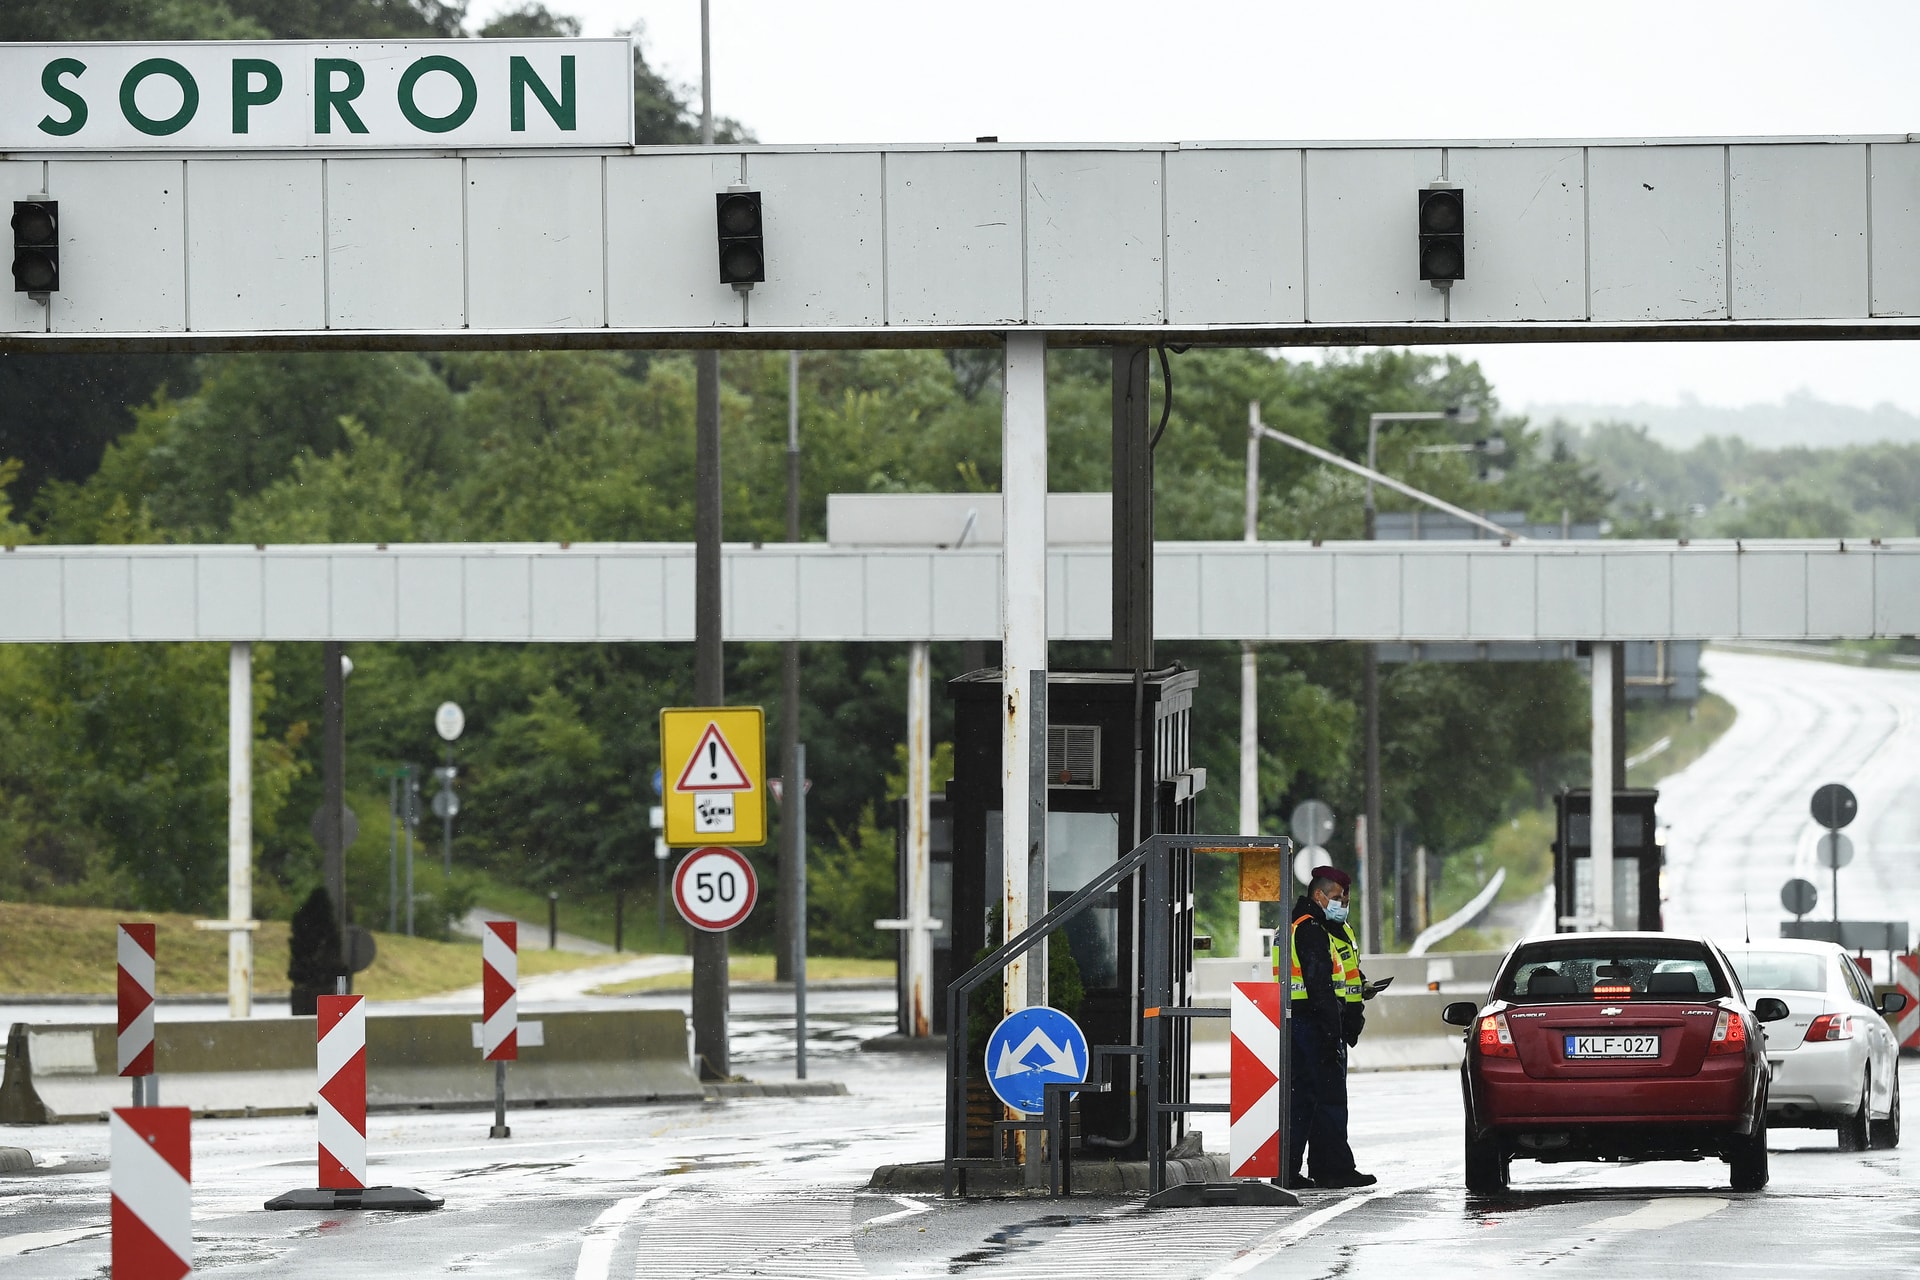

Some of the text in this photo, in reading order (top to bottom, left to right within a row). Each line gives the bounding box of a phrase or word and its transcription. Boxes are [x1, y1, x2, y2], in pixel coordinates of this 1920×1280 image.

[37, 55, 577, 137] SOPRON
[697, 872, 735, 903] 50
[1578, 1038, 1655, 1053] KLF-027
